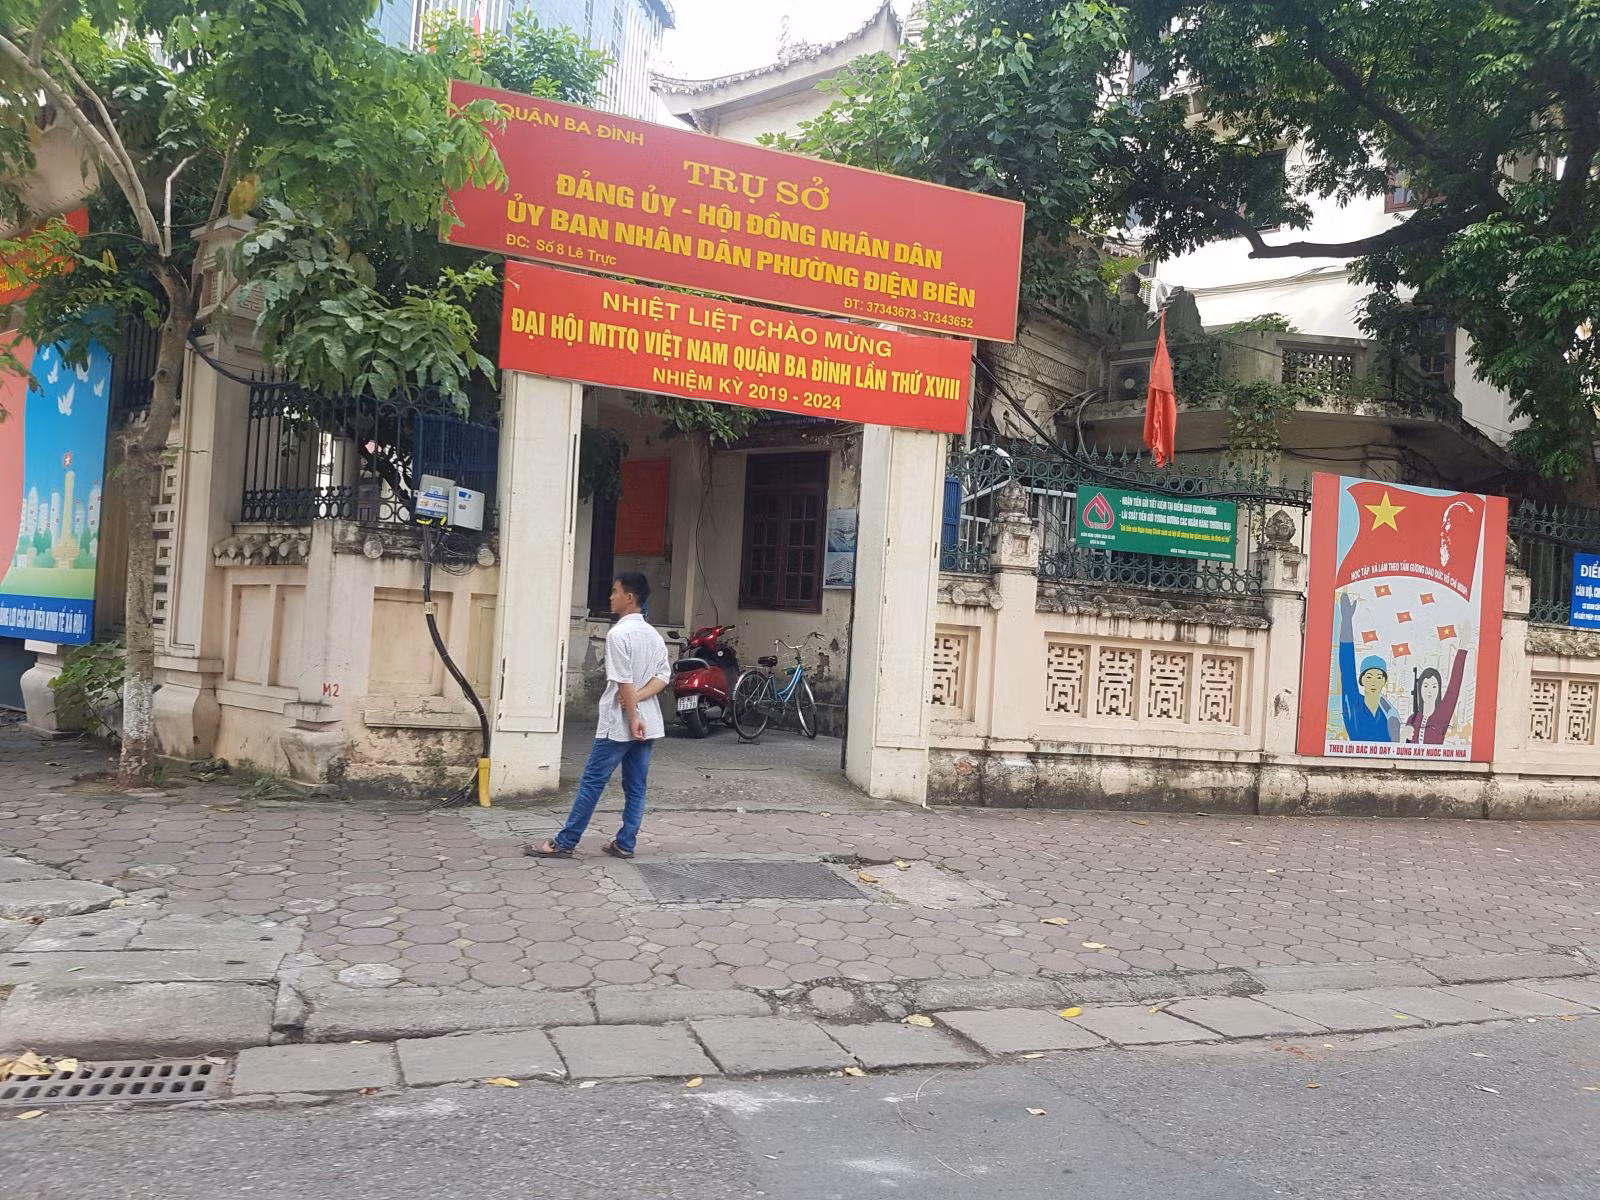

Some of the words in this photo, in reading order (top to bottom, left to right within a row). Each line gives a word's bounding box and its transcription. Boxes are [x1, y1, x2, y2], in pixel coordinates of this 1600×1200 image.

[564, 118, 591, 135] BA
[597, 124, 644, 146] ĐÌNH
[684, 161, 768, 204] TRỤ
[776, 176, 830, 211] SỞ
[557, 170, 634, 208] ĐẢNG
[641, 184, 676, 216] ỦY
[699, 204, 740, 233] HỘI
[746, 212, 816, 246] ĐỒNG
[821, 229, 888, 260] NHÂN
[894, 242, 942, 270] DÂN
[507, 194, 544, 226] ỦY
[550, 209, 609, 240] BAN
[615, 222, 692, 256] NHÂN
[697, 239, 751, 270] DÂN
[757, 251, 858, 288] PHƯỜNG
[864, 272, 918, 299] ĐIỆN
[922, 281, 975, 308] BIÊN
[536, 240, 554, 253] Số
[557, 244, 564, 255] 8
[568, 246, 583, 260] Lê
[588, 251, 616, 266] Trực
[603, 292, 680, 321] NHIỆT
[689, 307, 742, 332] LIỆT
[750, 318, 817, 345] CHÀO
[824, 330, 892, 358] MỪNG
[511, 308, 544, 340] ĐẠI
[551, 313, 583, 346] HỘI
[589, 321, 639, 354] MTTQ
[645, 329, 682, 362] VIỆT
[687, 338, 728, 366] NAM
[734, 346, 780, 378] QUẬN
[784, 355, 806, 379] BA
[811, 356, 851, 386] ĐÌNH
[856, 360, 886, 390] LẦN
[892, 370, 923, 395] THỨ
[924, 376, 960, 400] XVIII
[652, 367, 712, 392] NHIỆM
[719, 376, 743, 394] KỲ
[748, 384, 788, 402] 2019
[803, 392, 842, 410] 2024
[1581, 561, 1600, 578] ĐIỂ
